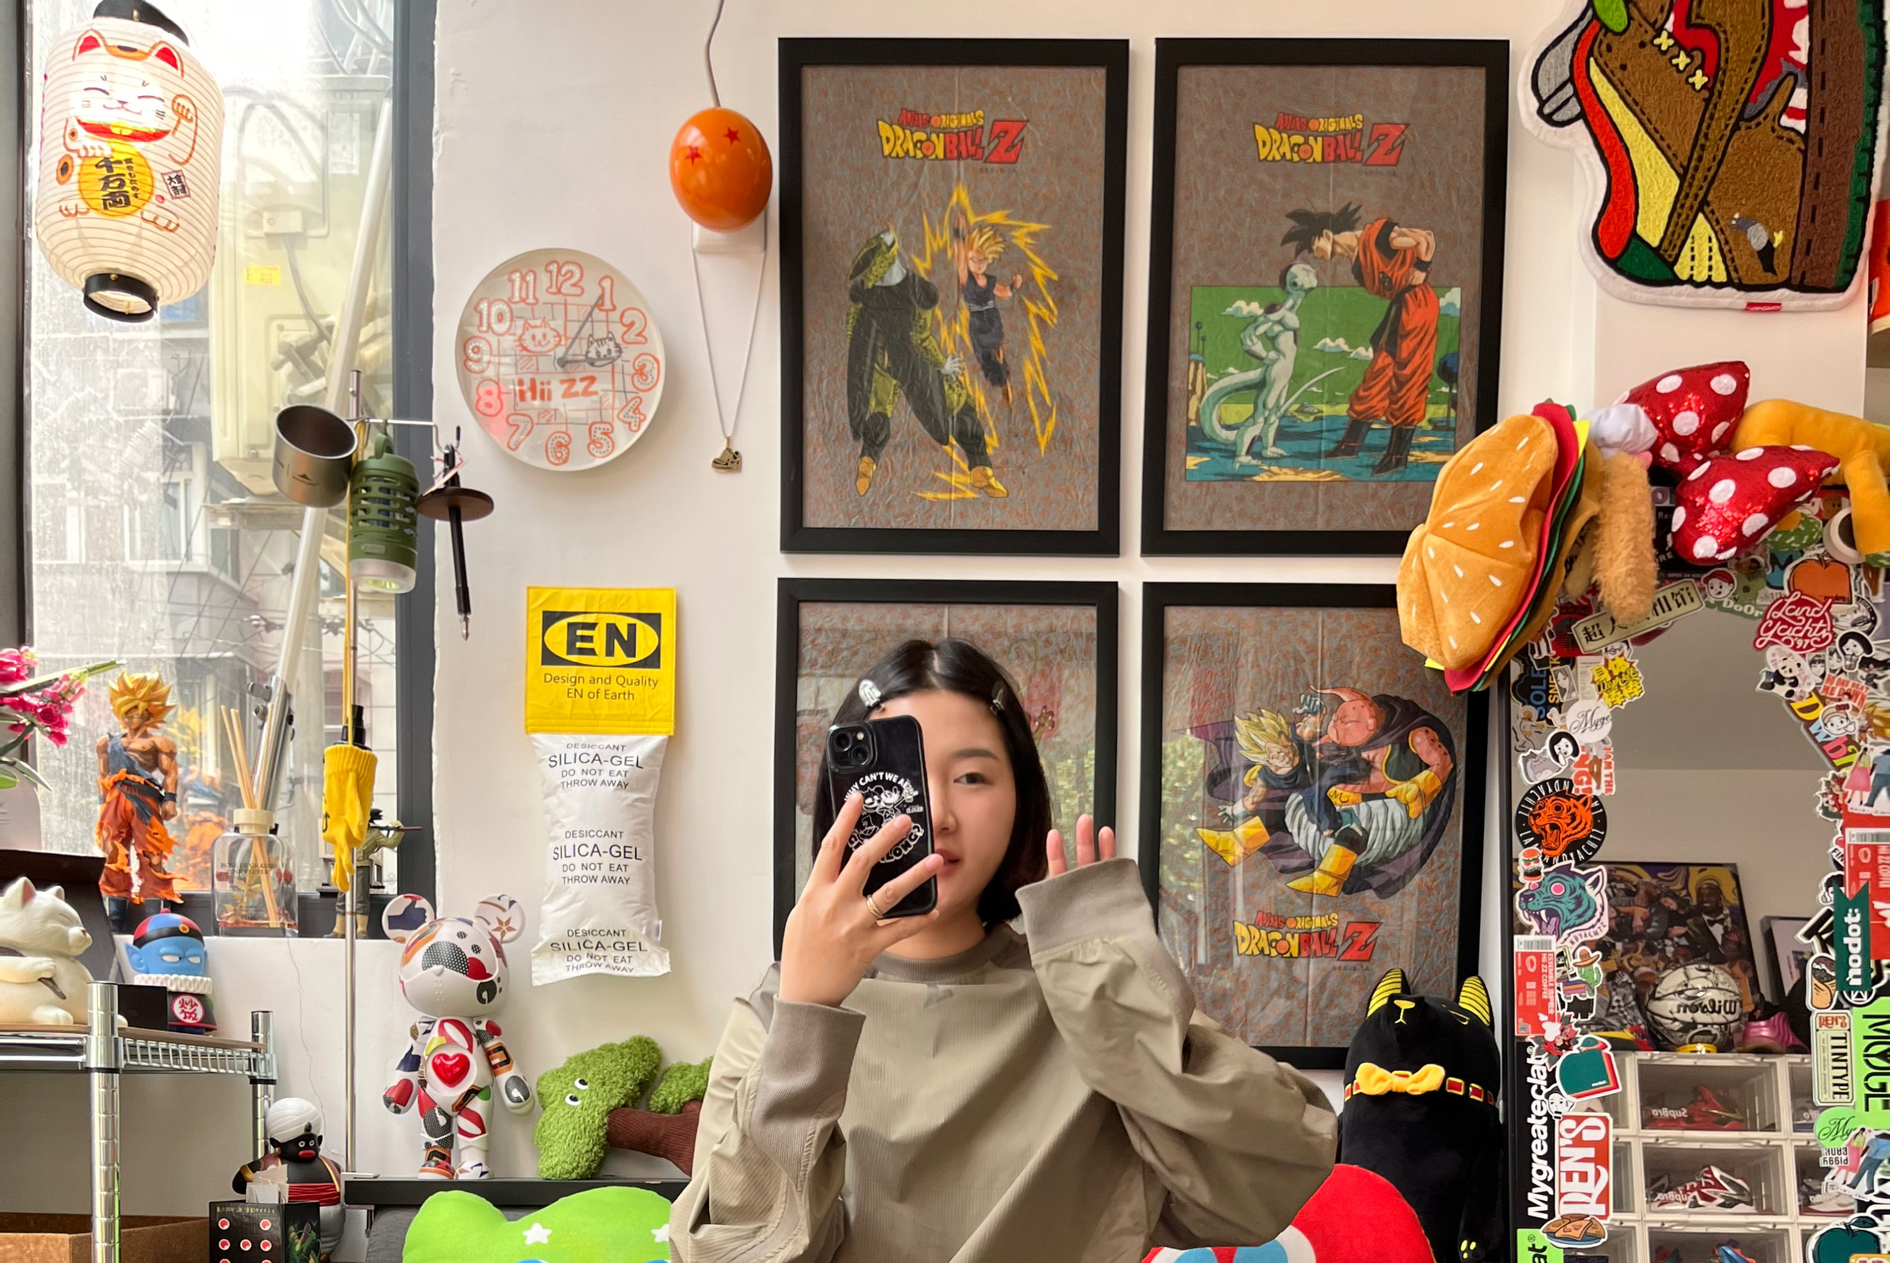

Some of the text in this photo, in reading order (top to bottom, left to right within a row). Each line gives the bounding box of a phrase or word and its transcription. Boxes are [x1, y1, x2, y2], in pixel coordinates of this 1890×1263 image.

[983, 119, 1031, 164] Z
[1362, 123, 1410, 167] Z
[508, 269, 539, 306] 11
[545, 260, 585, 297] 12
[597, 275, 617, 312] 1
[474, 298, 514, 336] 10
[619, 307, 648, 344] 2
[463, 336, 493, 374] 9
[631, 353, 660, 392] 3
[475, 378, 504, 417] 8
[617, 396, 647, 432] 4
[505, 413, 534, 451] 7
[545, 431, 572, 466] 6
[588, 421, 615, 459] 5
[566, 621, 637, 658] EN
[544, 672, 659, 689] Design and Quality
[567, 688, 635, 701] EN of Earth
[548, 752, 644, 769] SILICA-GEL
[566, 743, 626, 752] DESICCANT
[561, 768, 630, 778] DO NOT EAT
[561, 779, 630, 790] THROW AWAY
[858, 771, 884, 787] CAN'T
[884, 771, 899, 783] WE
[565, 829, 624, 839] DESICCANT
[552, 843, 643, 861] SILICA-GEL
[562, 862, 629, 873] DO NOT EAT
[562, 874, 631, 886] THROW AWAY
[550, 939, 648, 952] SILICA-GEL
[567, 929, 627, 938] DESICCANT
[1336, 921, 1384, 962] Z
[566, 952, 633, 964] DO NOT EAT
[566, 961, 634, 974] THROW AWAY
[1831, 1033, 1849, 1100] TINTYPE
